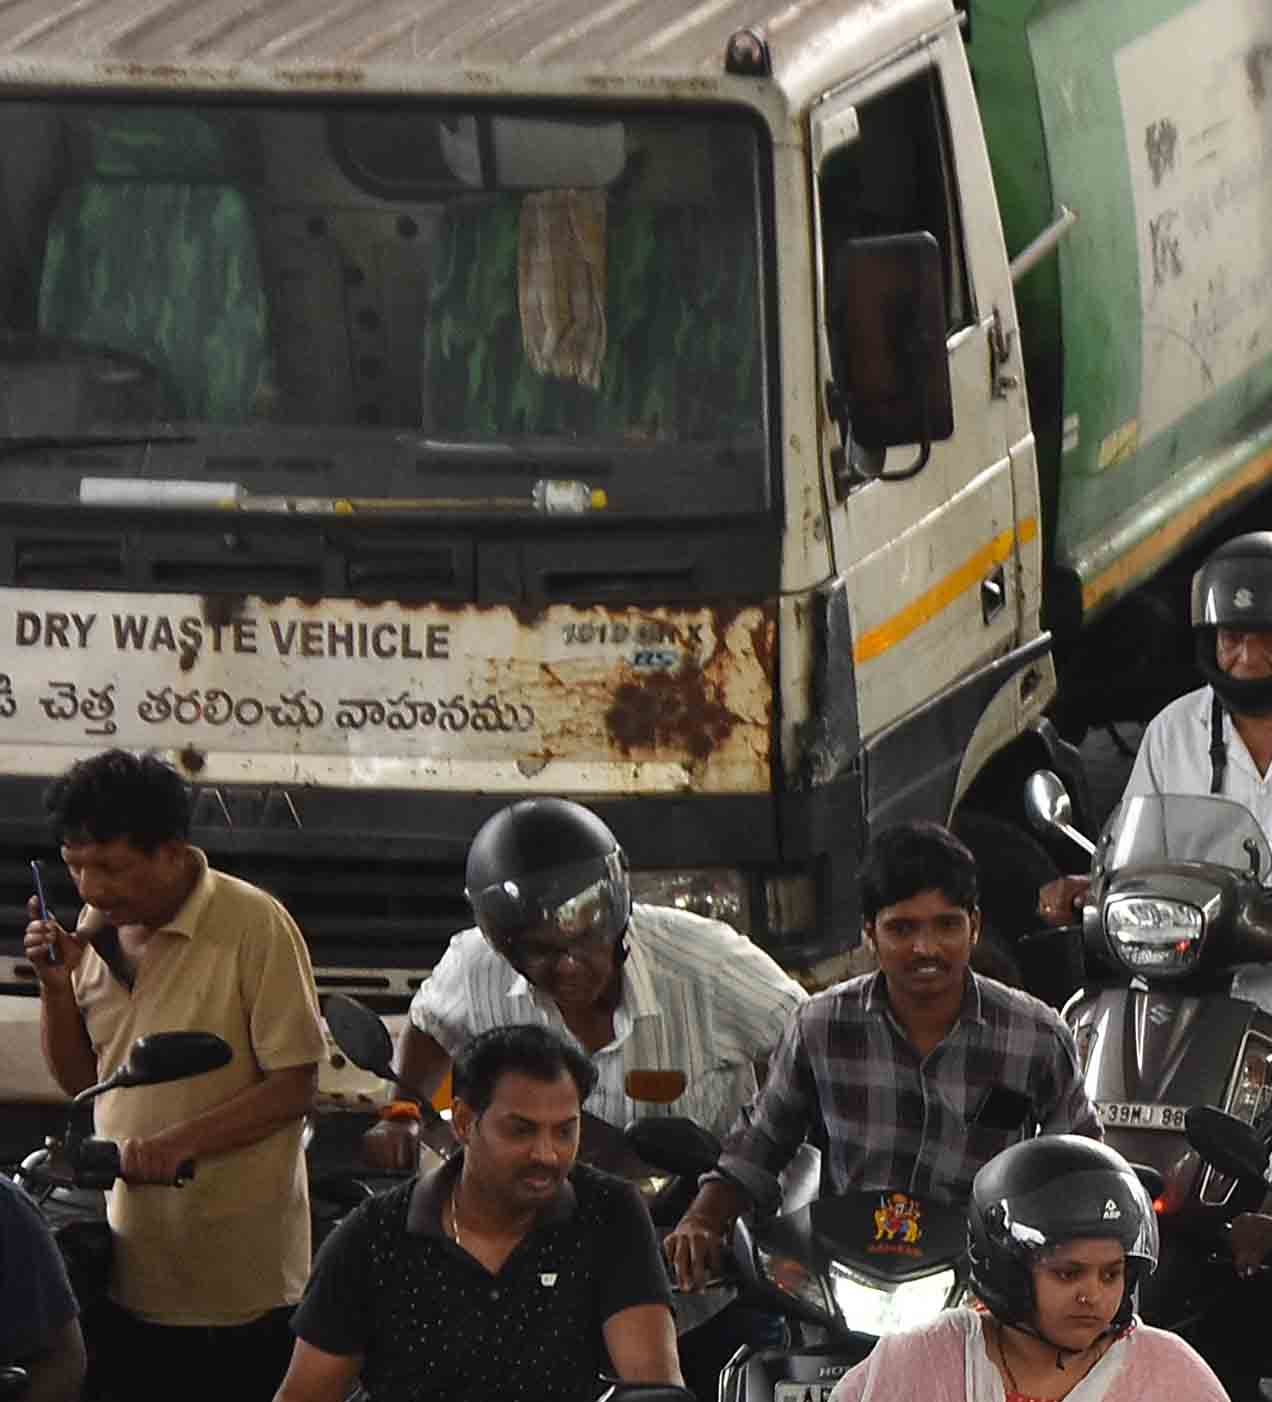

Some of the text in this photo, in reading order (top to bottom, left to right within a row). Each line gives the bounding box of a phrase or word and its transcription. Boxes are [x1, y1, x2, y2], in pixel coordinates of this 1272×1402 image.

[15, 611, 451, 659] DRY WASTE VEHICLE
[38, 680, 118, 736] చెత్త
[137, 686, 325, 729] తరలించు
